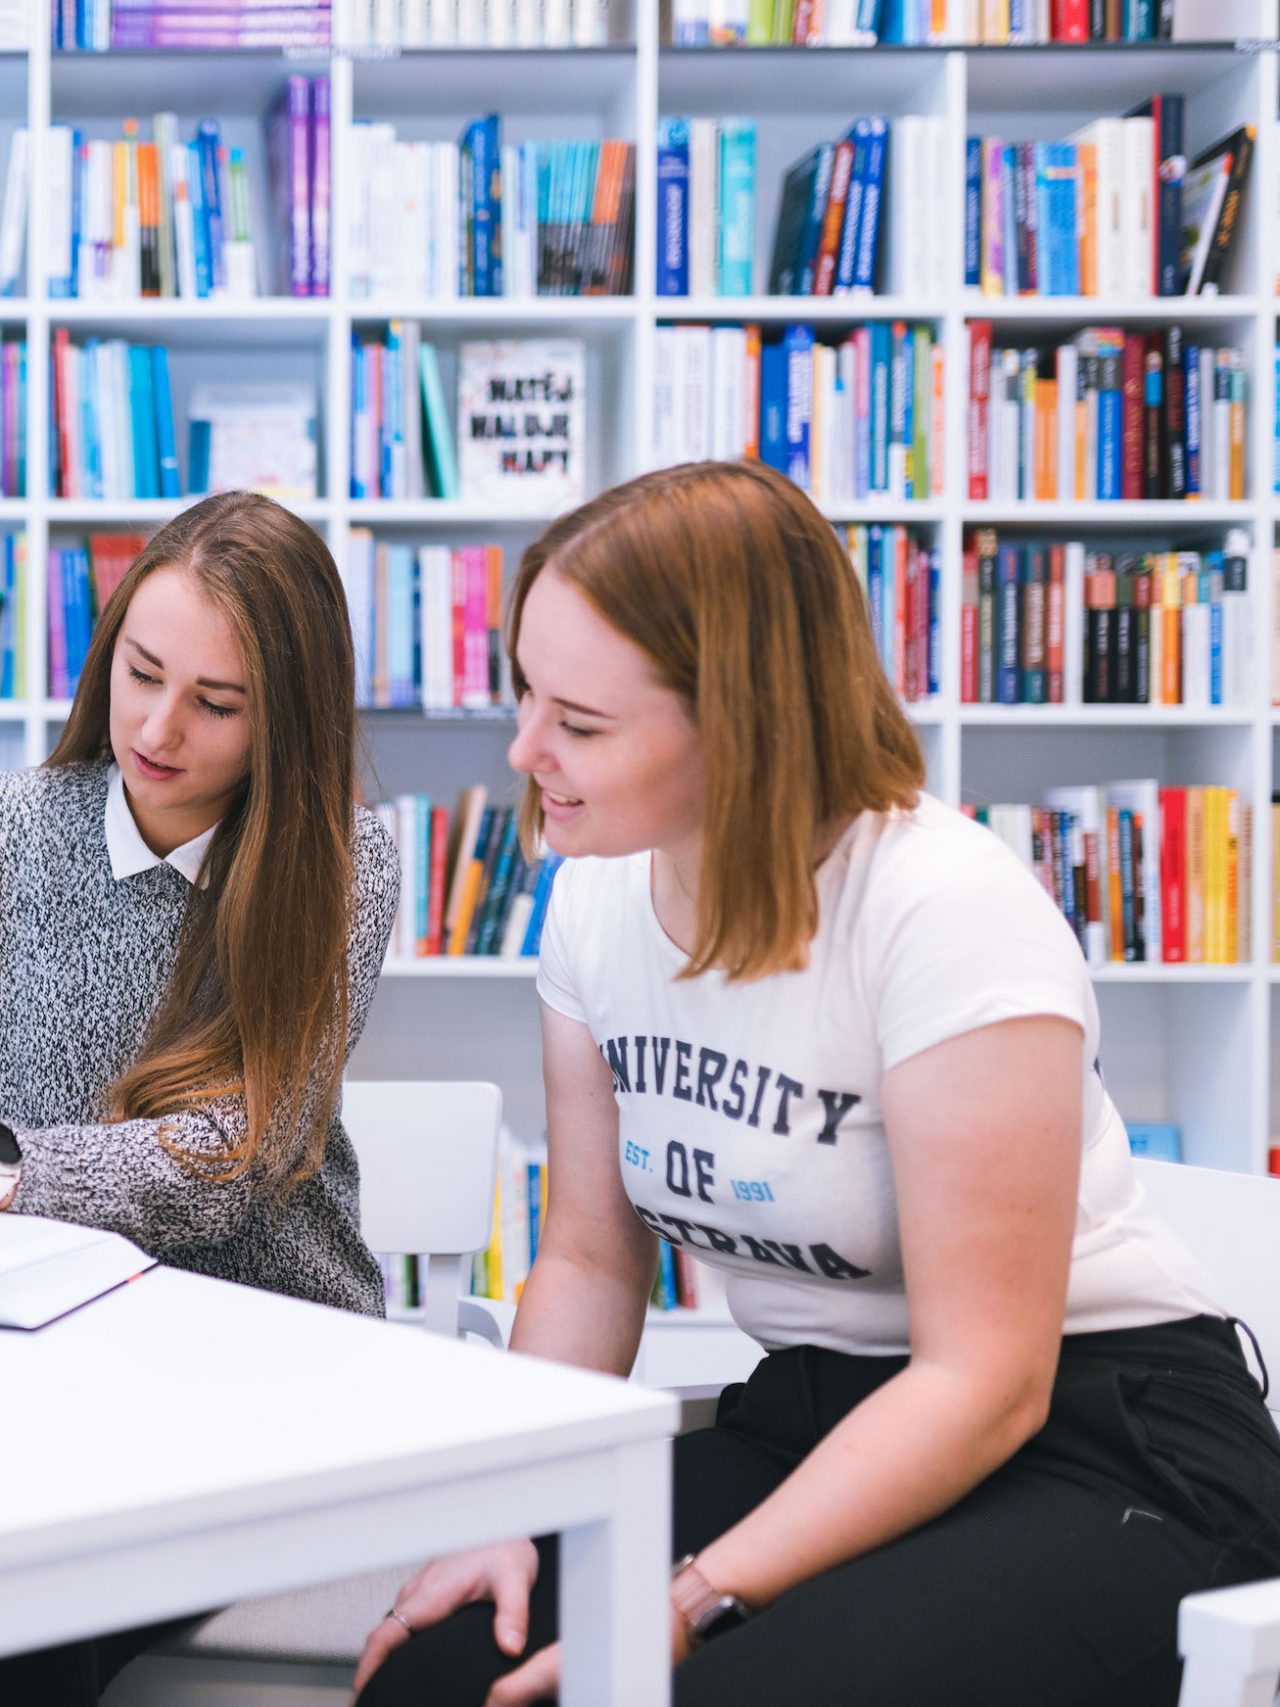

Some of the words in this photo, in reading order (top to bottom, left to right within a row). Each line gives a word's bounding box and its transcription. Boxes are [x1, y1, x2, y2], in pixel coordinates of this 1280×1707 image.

[600, 1035, 862, 1146] NIVERSITY
[625, 1140, 653, 1173] EST.
[730, 1178, 775, 1203] 1991
[666, 1139, 716, 1205] OF
[633, 1203, 873, 1281] STRAVA
